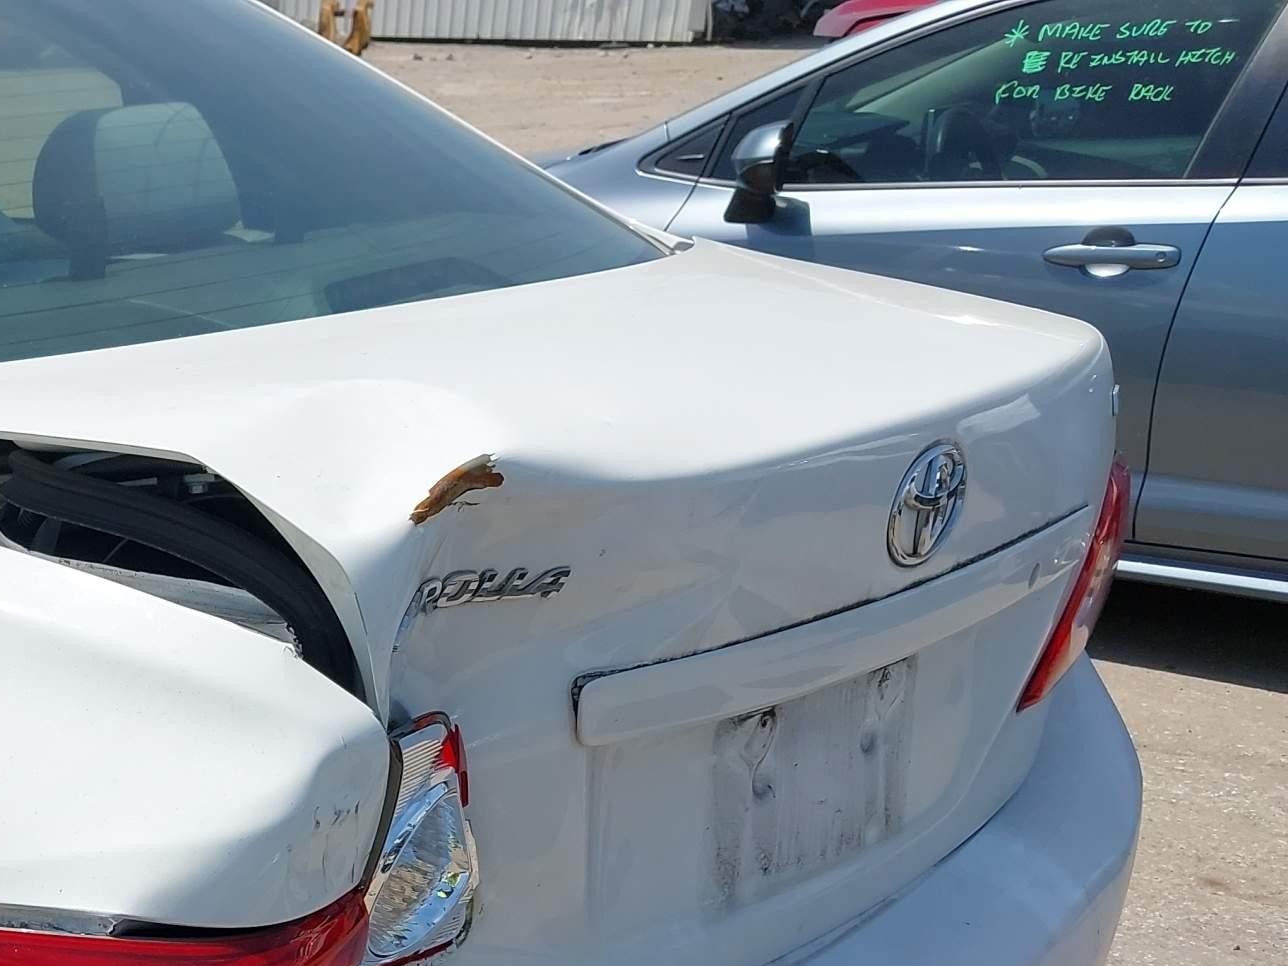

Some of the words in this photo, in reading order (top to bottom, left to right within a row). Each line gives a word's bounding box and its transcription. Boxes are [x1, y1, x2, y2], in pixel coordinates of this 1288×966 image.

[1038, 22, 1111, 42] MAKE
[1116, 19, 1176, 39] SURE
[1184, 20, 1213, 34] TO
[1175, 47, 1236, 67] HITCH
[995, 81, 1040, 104] FOR
[1054, 84, 1113, 101] BIKE
[1128, 83, 1176, 102] RACK
